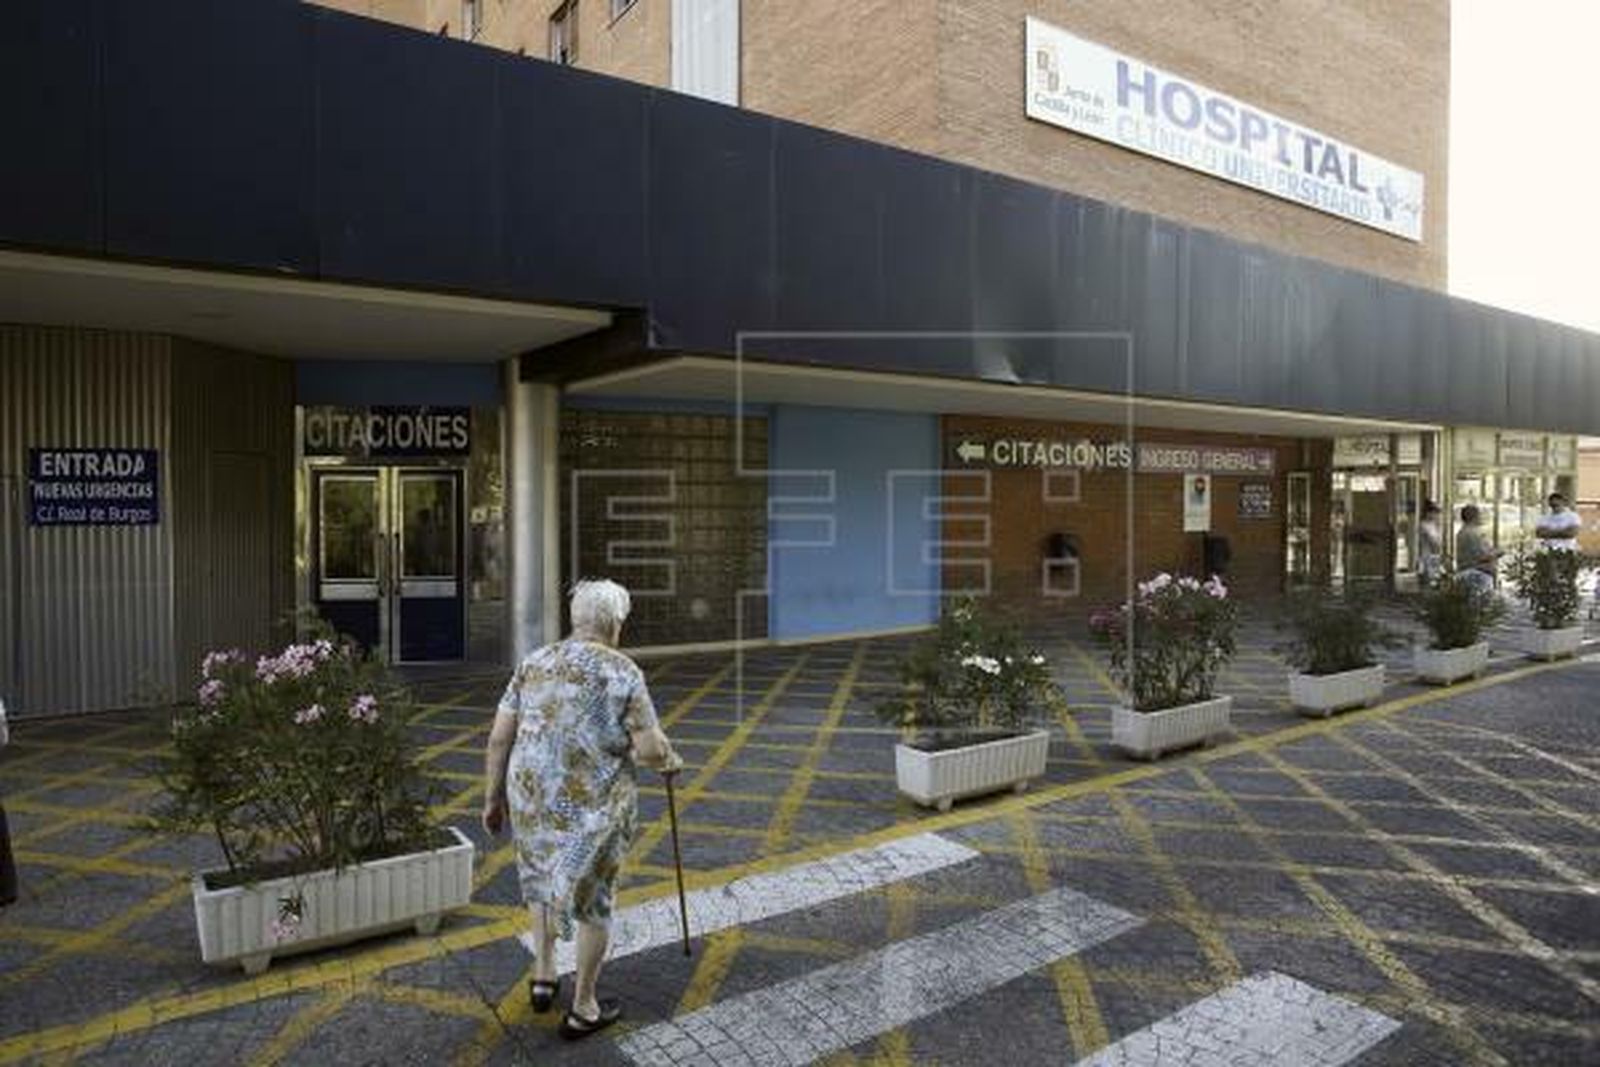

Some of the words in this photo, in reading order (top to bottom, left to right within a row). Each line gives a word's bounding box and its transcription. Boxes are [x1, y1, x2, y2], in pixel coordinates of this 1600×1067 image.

[1116, 59, 1369, 194] HOSPITAL
[306, 414, 468, 449] CITACIONES
[41, 452, 146, 476] ENTRADA
[993, 440, 1132, 469] CITACIONES
[84, 482, 153, 499] URGENCIAS
[90, 507, 105, 521] de
[108, 506, 151, 524] Burgos
